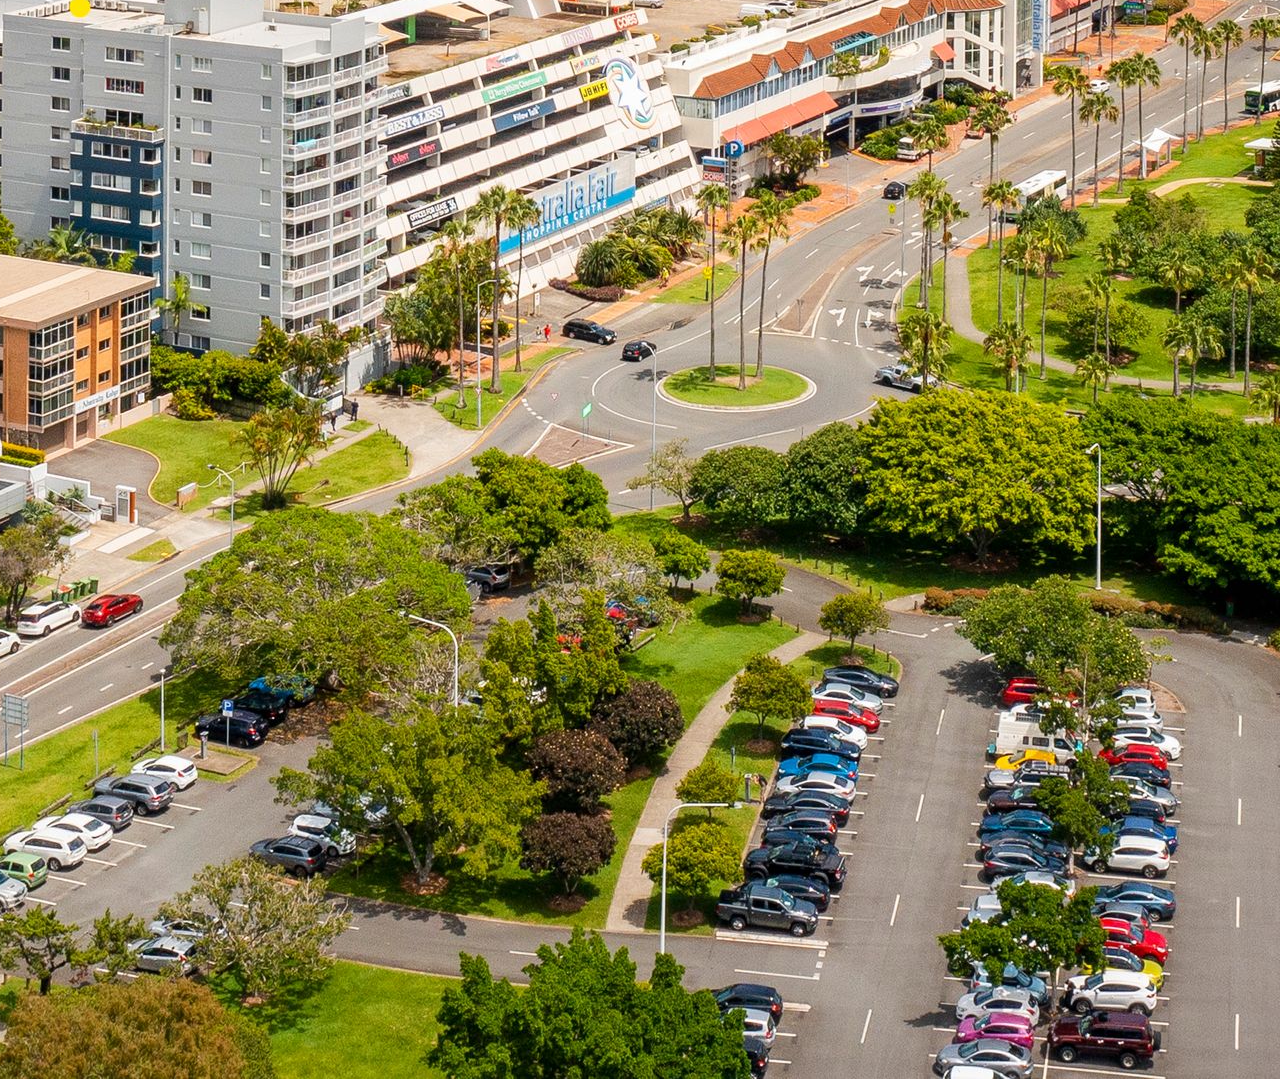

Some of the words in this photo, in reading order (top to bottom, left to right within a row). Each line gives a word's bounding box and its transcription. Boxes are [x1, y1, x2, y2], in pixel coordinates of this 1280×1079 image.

[616, 13, 638, 30] coles
[1033, 27, 1044, 51] Fair
[583, 87, 593, 98] JB
[587, 167, 618, 205] Fair
[521, 212, 569, 245] SHOPPING
[573, 197, 608, 222] CENTRE
